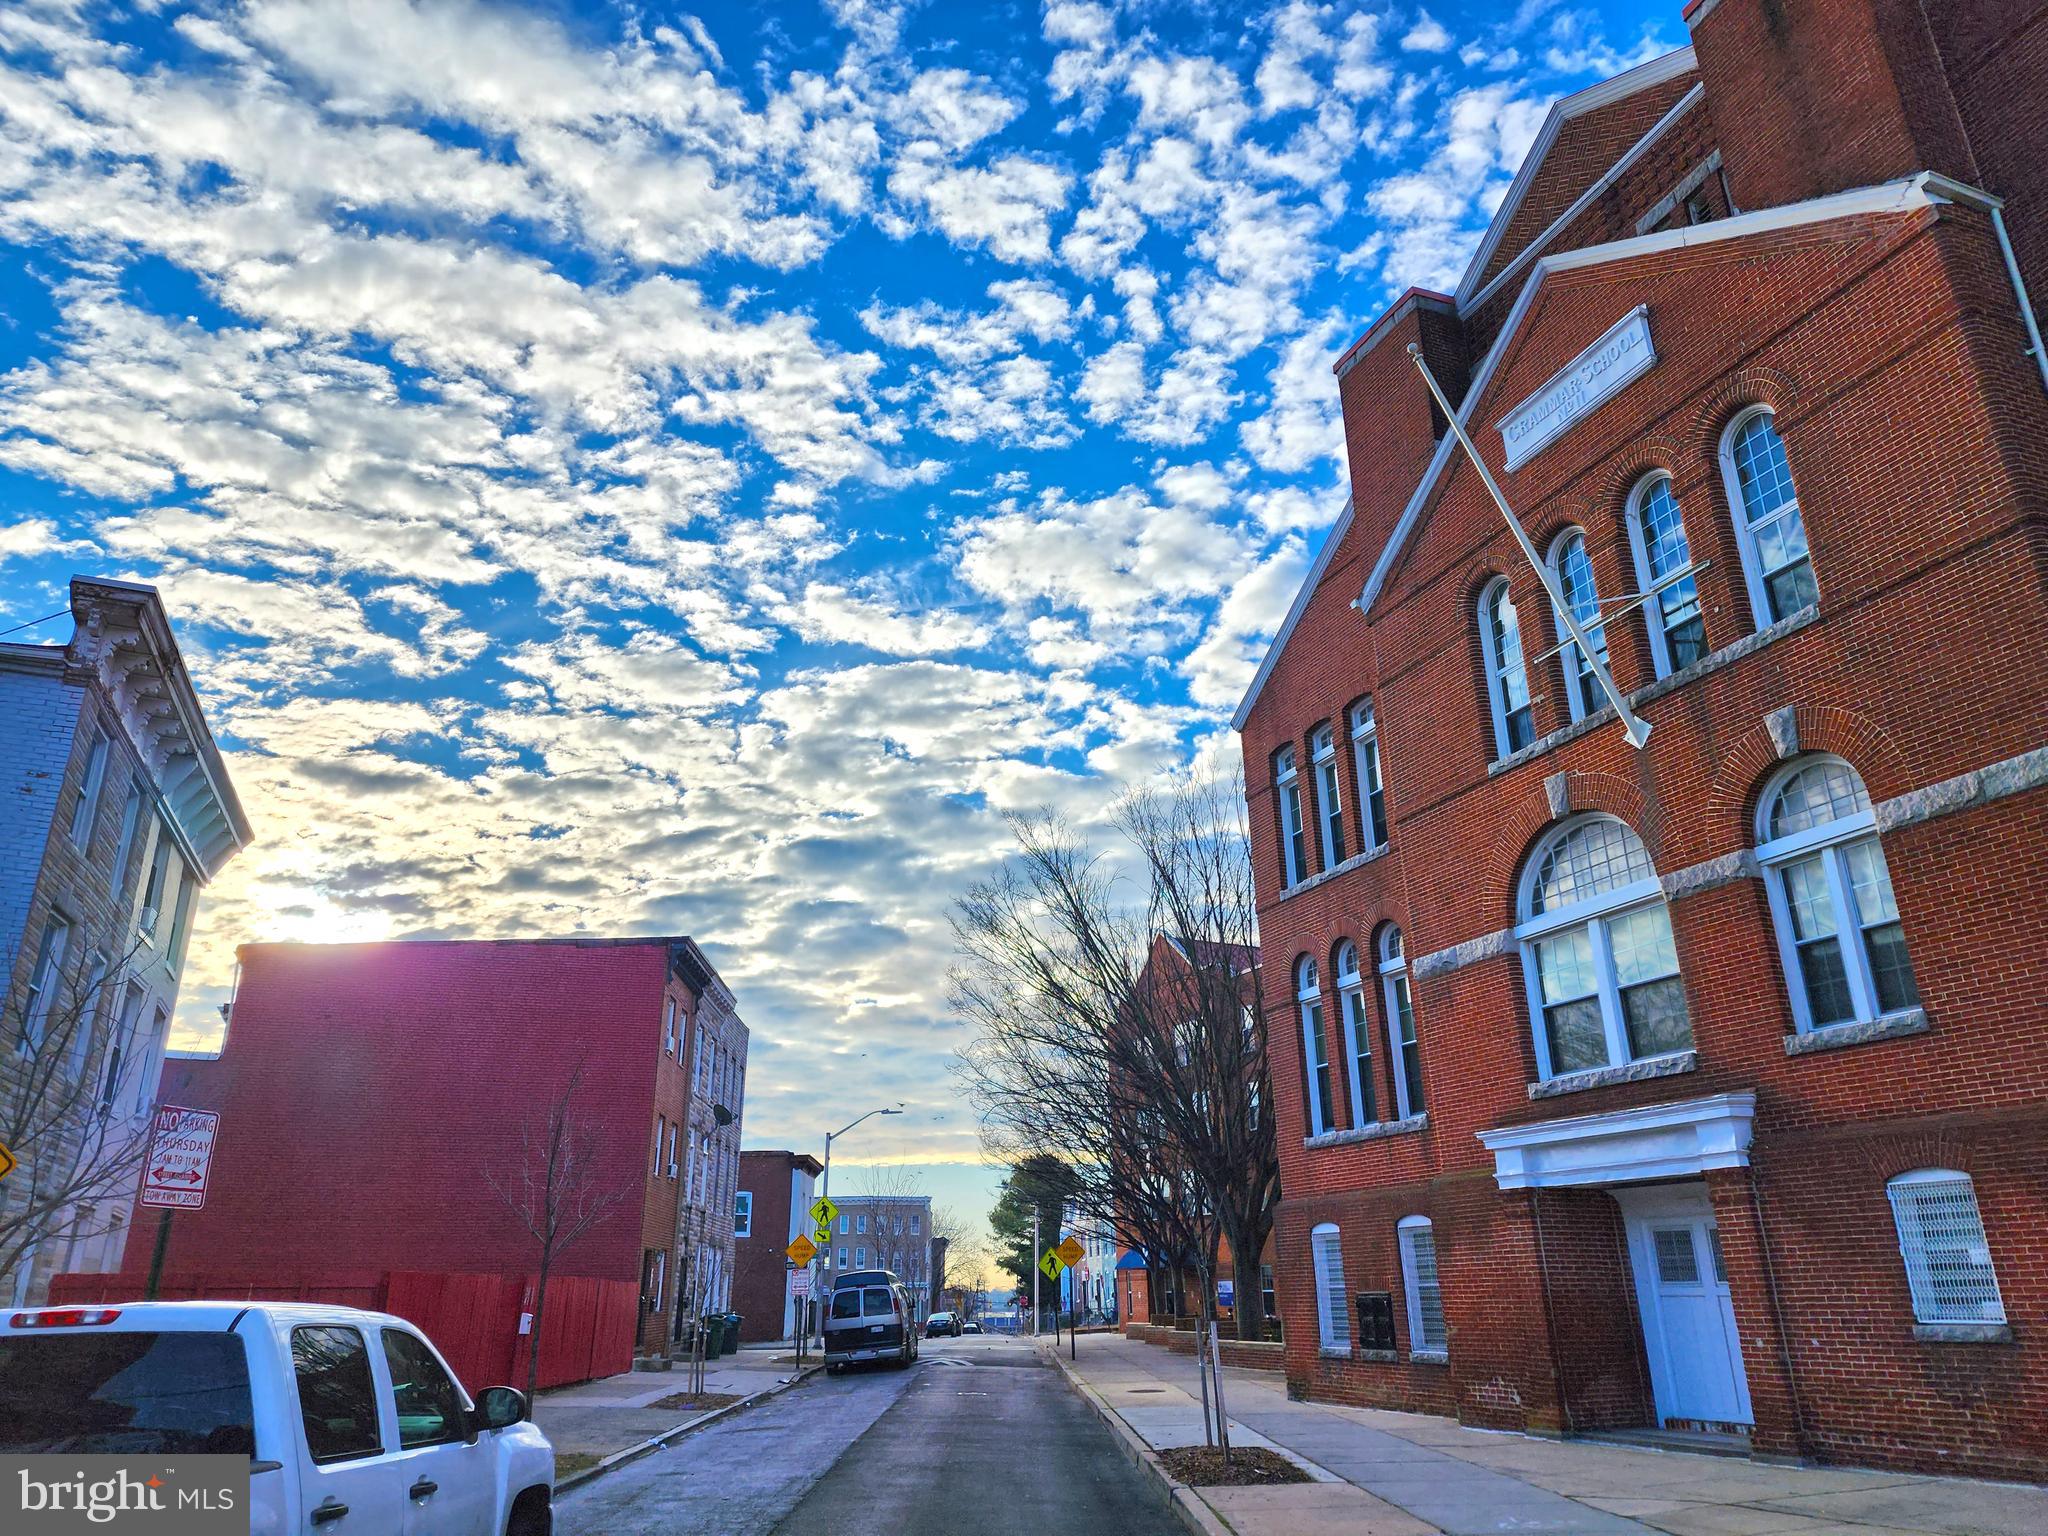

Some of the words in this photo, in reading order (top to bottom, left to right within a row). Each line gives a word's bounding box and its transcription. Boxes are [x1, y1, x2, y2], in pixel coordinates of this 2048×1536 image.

[1581, 331, 1643, 385] SCHOOL
[160, 1110, 179, 1130] NO
[156, 1136, 211, 1153] THURSDAY
[146, 1189, 161, 1201] TOW
[182, 1192, 201, 1204] ZONE
